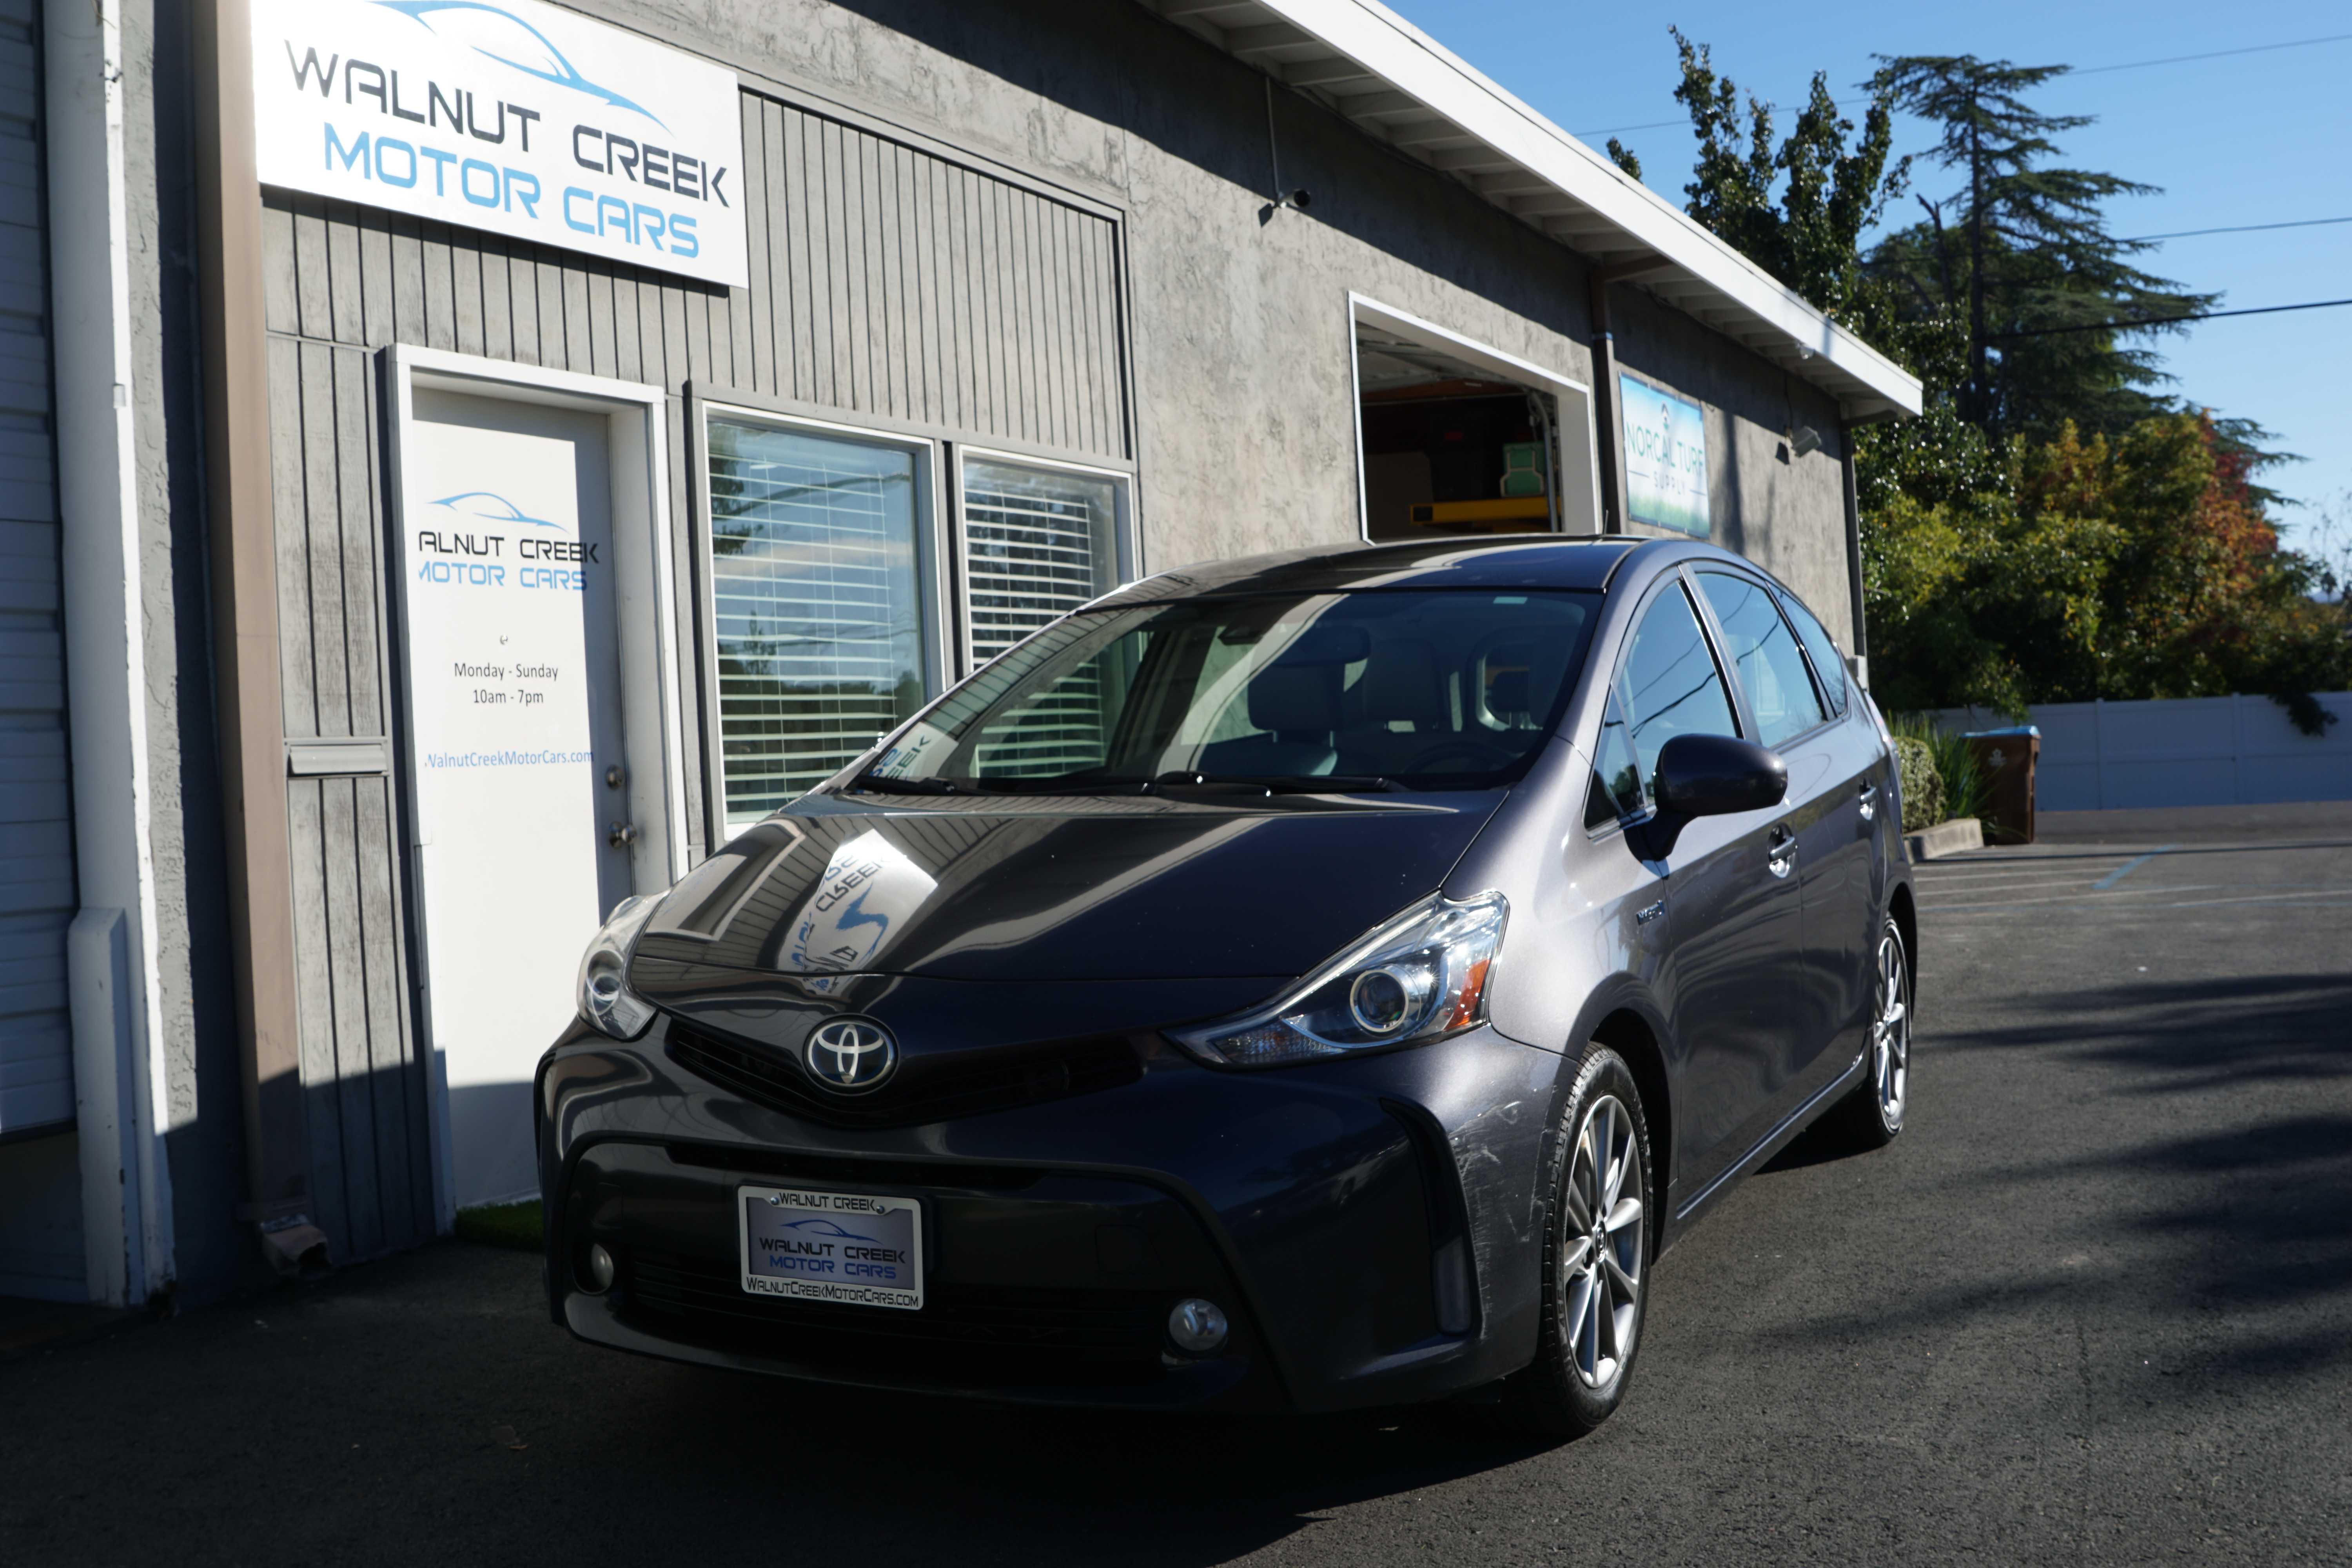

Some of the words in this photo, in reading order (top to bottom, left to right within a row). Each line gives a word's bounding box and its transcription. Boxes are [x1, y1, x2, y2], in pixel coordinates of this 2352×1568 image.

[284, 39, 541, 152] WALNUT
[572, 124, 730, 208] CREEK
[324, 121, 541, 220] MOTOR
[563, 185, 699, 258] CARS
[1626, 421, 1676, 468] NORCAL
[1677, 440, 1704, 477] TURF
[520, 538, 599, 564] CREEK
[520, 567, 587, 591] CARS
[454, 662, 505, 681] Monday
[516, 663, 558, 682] Sunday
[473, 689, 506, 703] 10am
[518, 689, 544, 707] 7pm
[779, 1192, 829, 1208] WALNUT
[833, 1197, 877, 1212] CREEK
[759, 1237, 835, 1256] WALNUT
[844, 1246, 906, 1264] CREEK
[769, 1254, 835, 1273] MOTOR
[844, 1262, 897, 1279] CARS
